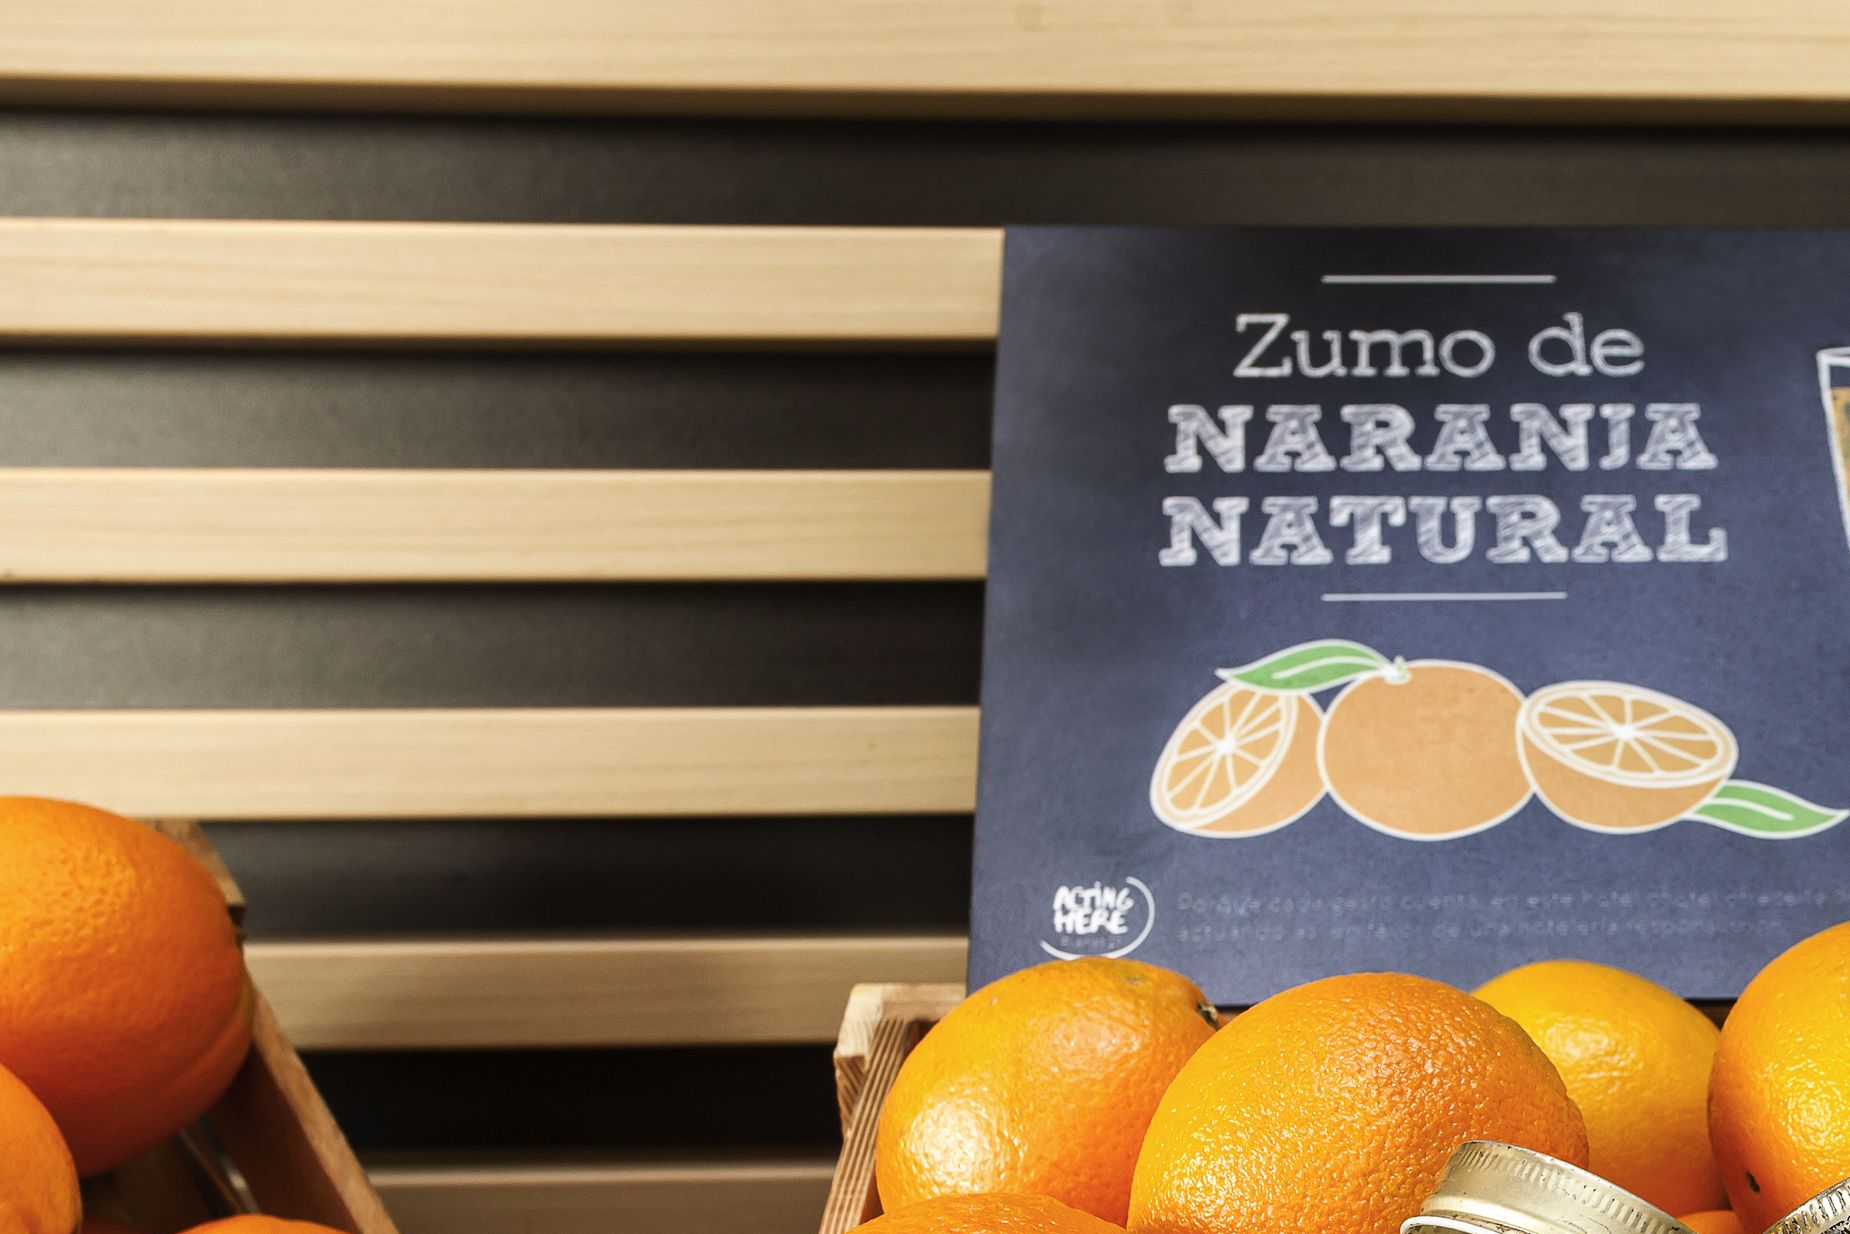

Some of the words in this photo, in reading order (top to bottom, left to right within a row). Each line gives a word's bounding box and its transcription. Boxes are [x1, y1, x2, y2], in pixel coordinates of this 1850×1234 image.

[1233, 312, 1496, 377] Zumo
[1528, 311, 1645, 377] de
[1163, 402, 1718, 473] NARANJA
[1158, 494, 1728, 568] NATURAL
[1053, 881, 1135, 911] ACTING
[1053, 908, 1129, 935] HERE
